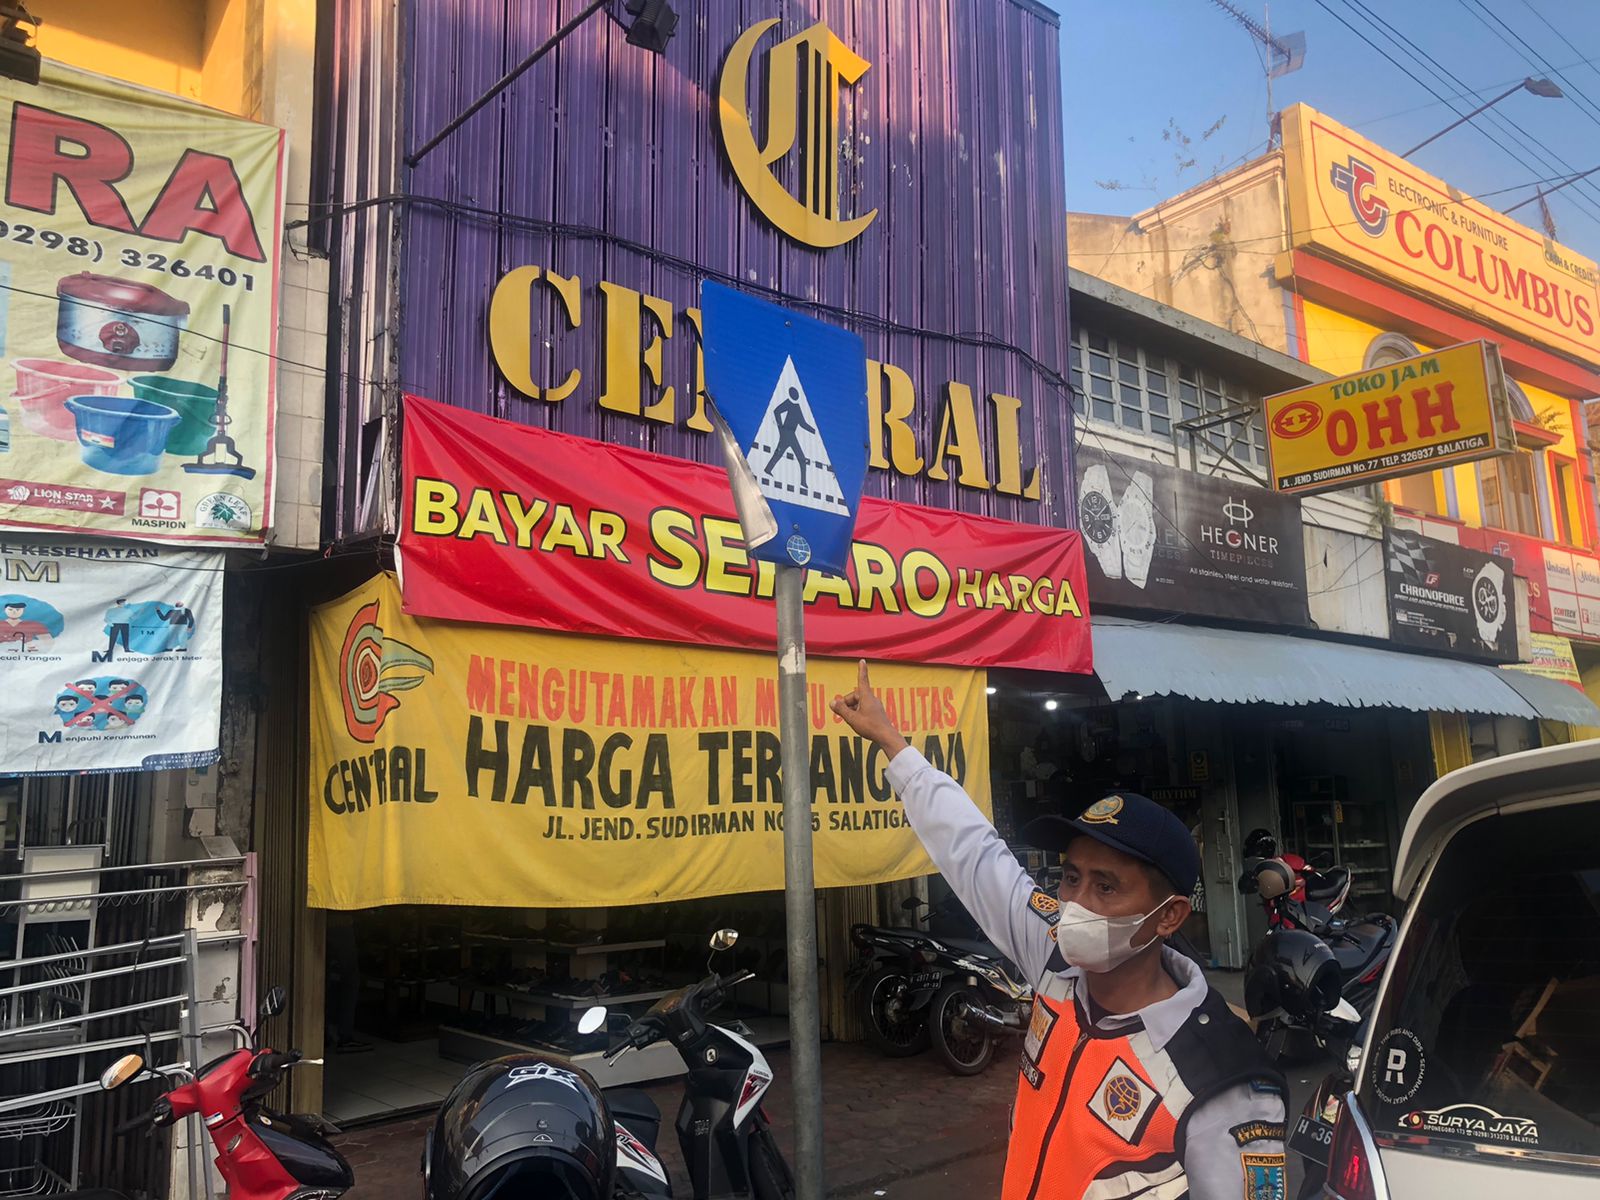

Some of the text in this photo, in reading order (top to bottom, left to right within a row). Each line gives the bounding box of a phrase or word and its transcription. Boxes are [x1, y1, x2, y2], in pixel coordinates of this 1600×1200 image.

[5, 100, 267, 263] RA
[1388, 177, 1509, 251] ELECTRONIC & FURNITURE
[120, 247, 254, 292] 326401
[1394, 209, 1594, 337] COLUMBUS
[489, 264, 1041, 501] CERAL
[1330, 357, 1441, 401] TOKO JAM
[1325, 380, 1462, 457] OHH
[1294, 474, 1312, 486] JEND
[1313, 465, 1353, 482] SUDIRMAN
[1368, 460, 1379, 470] 77
[1401, 447, 1434, 464] 326937
[1437, 437, 1485, 455] SALATIGA
[33, 488, 94, 503] LION STAR
[131, 518, 187, 530] MASPION
[1200, 524, 1280, 555] HEGNER
[21, 544, 159, 559] KESEHATAN
[411, 476, 631, 564] BAYAR
[956, 565, 1084, 618] HARGA
[1209, 549, 1275, 568] TIMEPIECES
[1399, 582, 1465, 607] CHRONOFORCE
[466, 654, 738, 729] MENGUTAMAKAN
[323, 745, 439, 815] CENRAL
[465, 714, 967, 810] HARGA TERANGAU
[542, 815, 574, 840] JL.
[579, 816, 642, 841] JEND.
[646, 810, 755, 840] SUDIRMAN
[829, 808, 912, 832] SALATIGA
[1298, 1119, 1310, 1134] H
[1315, 1127, 1334, 1145] 36
[1424, 1124, 1455, 1134] DIPONEGORO
[1510, 1135, 1539, 1145] SALATIGA
[1427, 1114, 1539, 1138] SURYA JAYA
